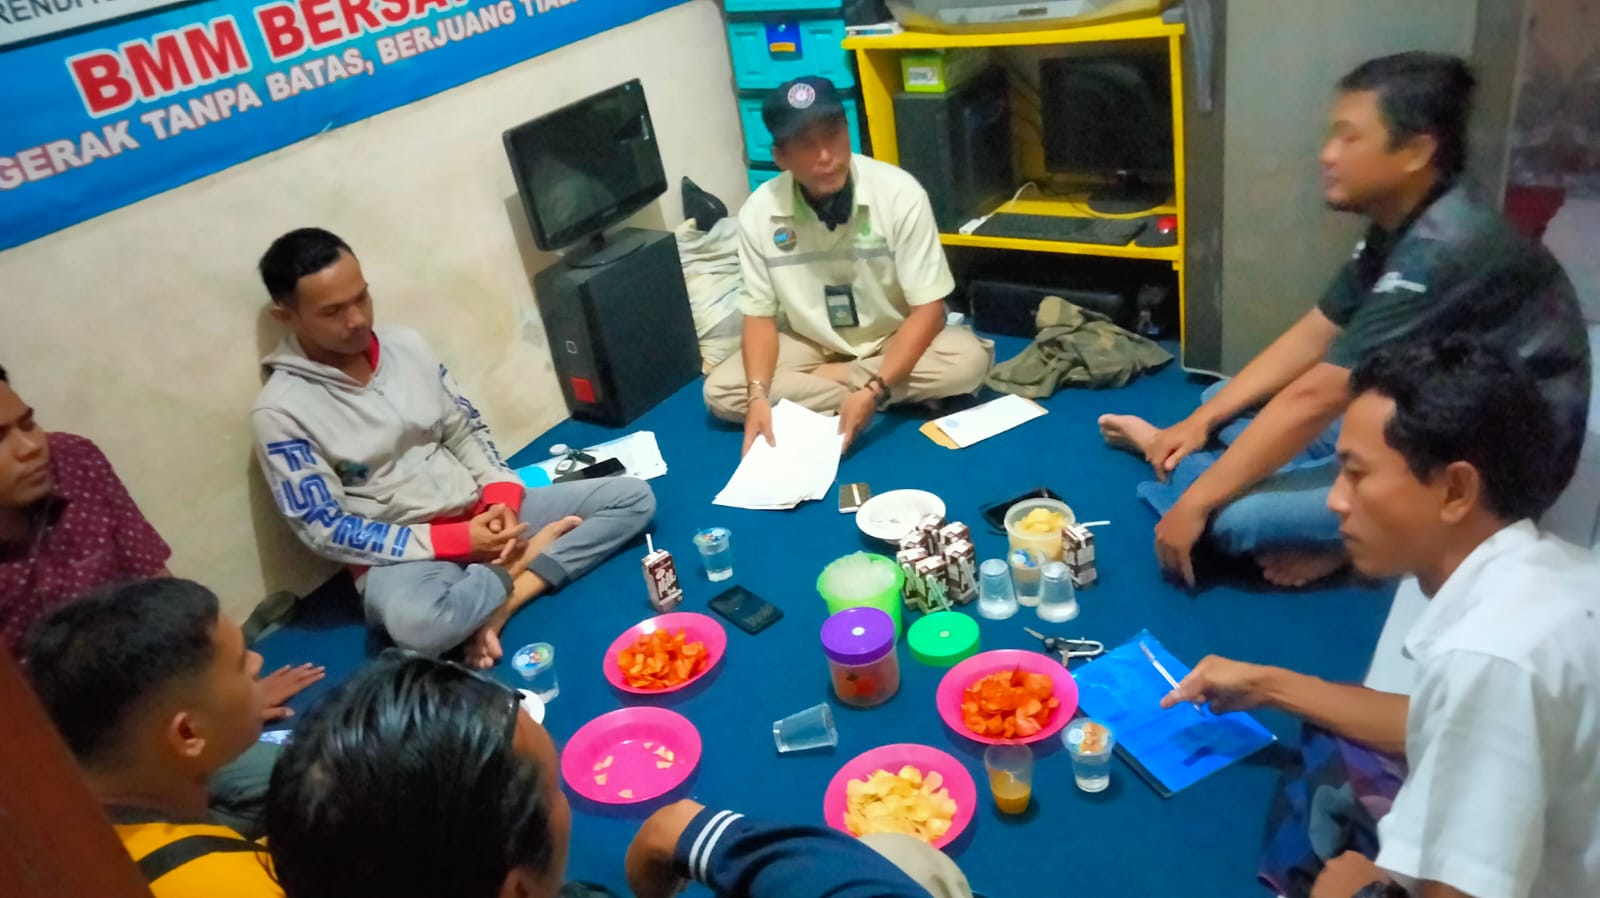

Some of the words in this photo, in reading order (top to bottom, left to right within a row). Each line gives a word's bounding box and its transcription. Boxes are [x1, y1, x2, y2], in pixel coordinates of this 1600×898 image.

[0, 120, 140, 190] GERAK
[141, 83, 263, 140] TANPA
[265, 48, 374, 101] BATAS,
[376, 0, 516, 64] BERJUANG
[67, 17, 251, 117] BMM
[257, 0, 467, 61] BERS
